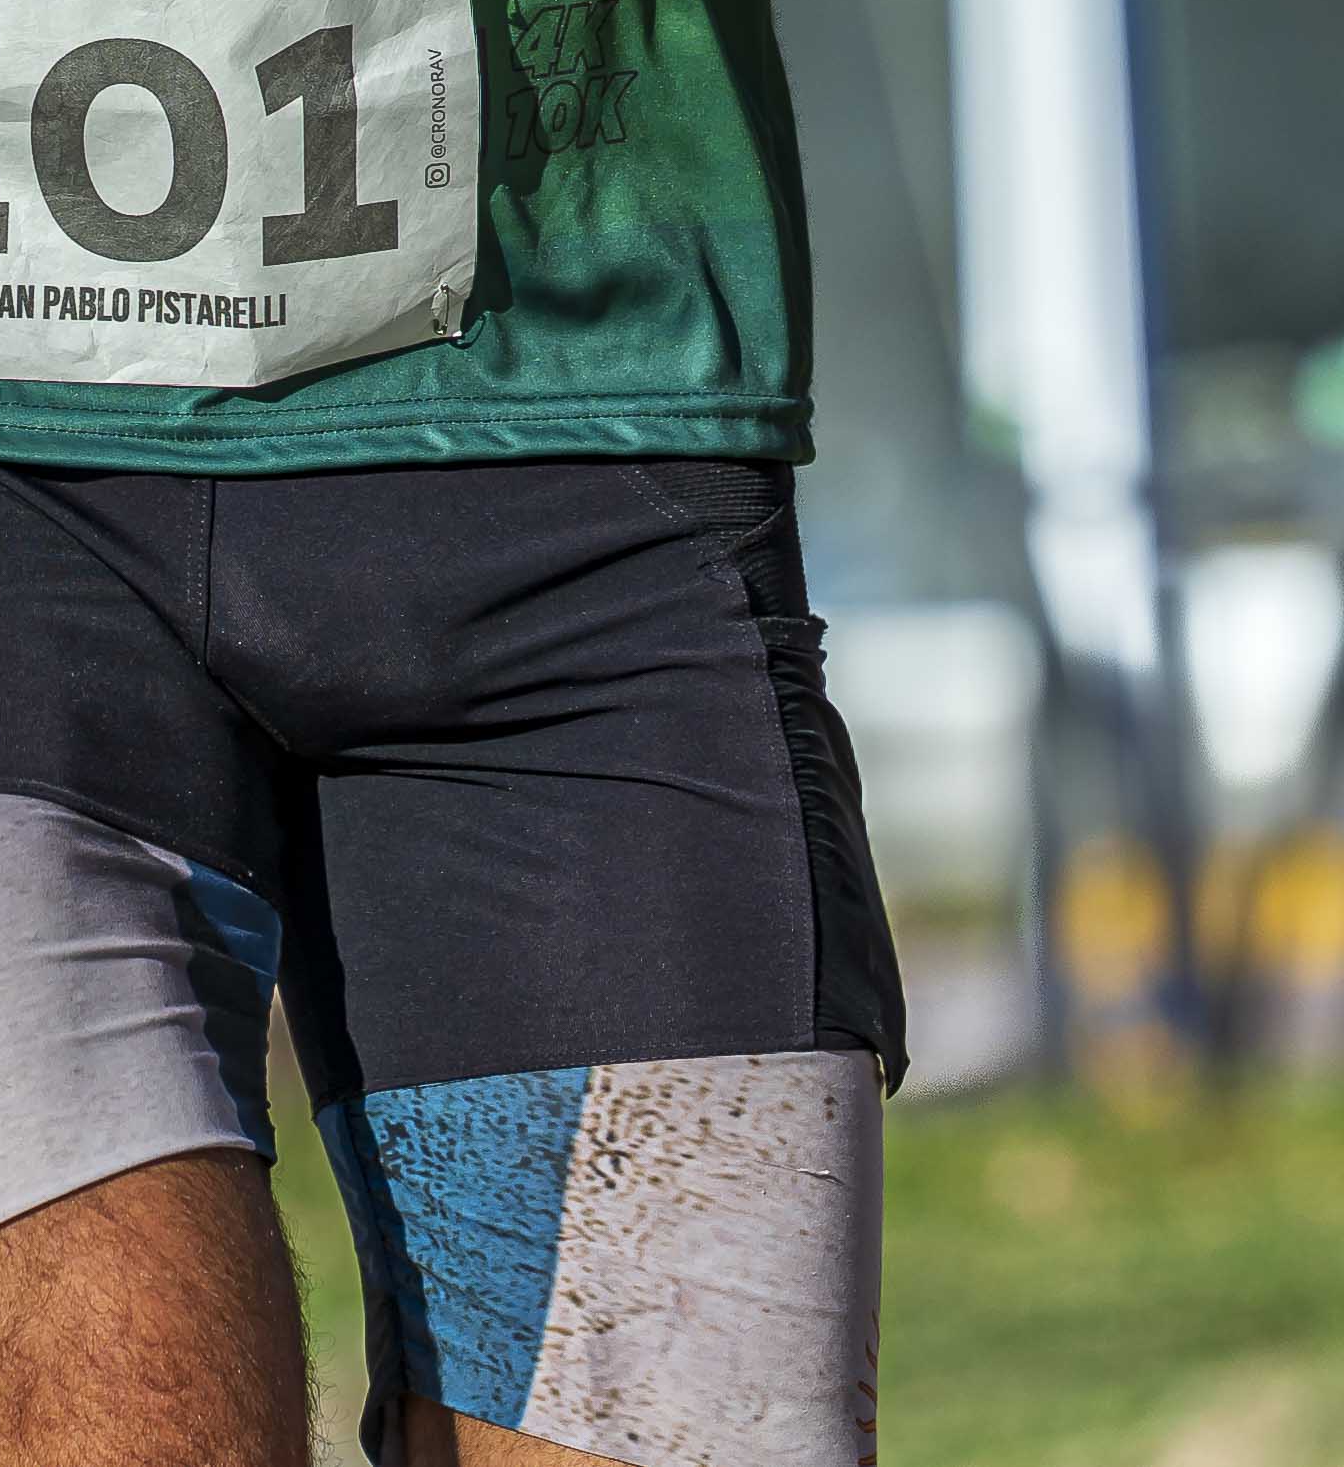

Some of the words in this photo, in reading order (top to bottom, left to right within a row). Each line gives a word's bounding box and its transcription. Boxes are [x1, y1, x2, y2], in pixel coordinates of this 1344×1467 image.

[428, 48, 446, 159] @CRONORAV
[41, 284, 131, 324] PABLO
[137, 289, 288, 329] PISTARELLI
